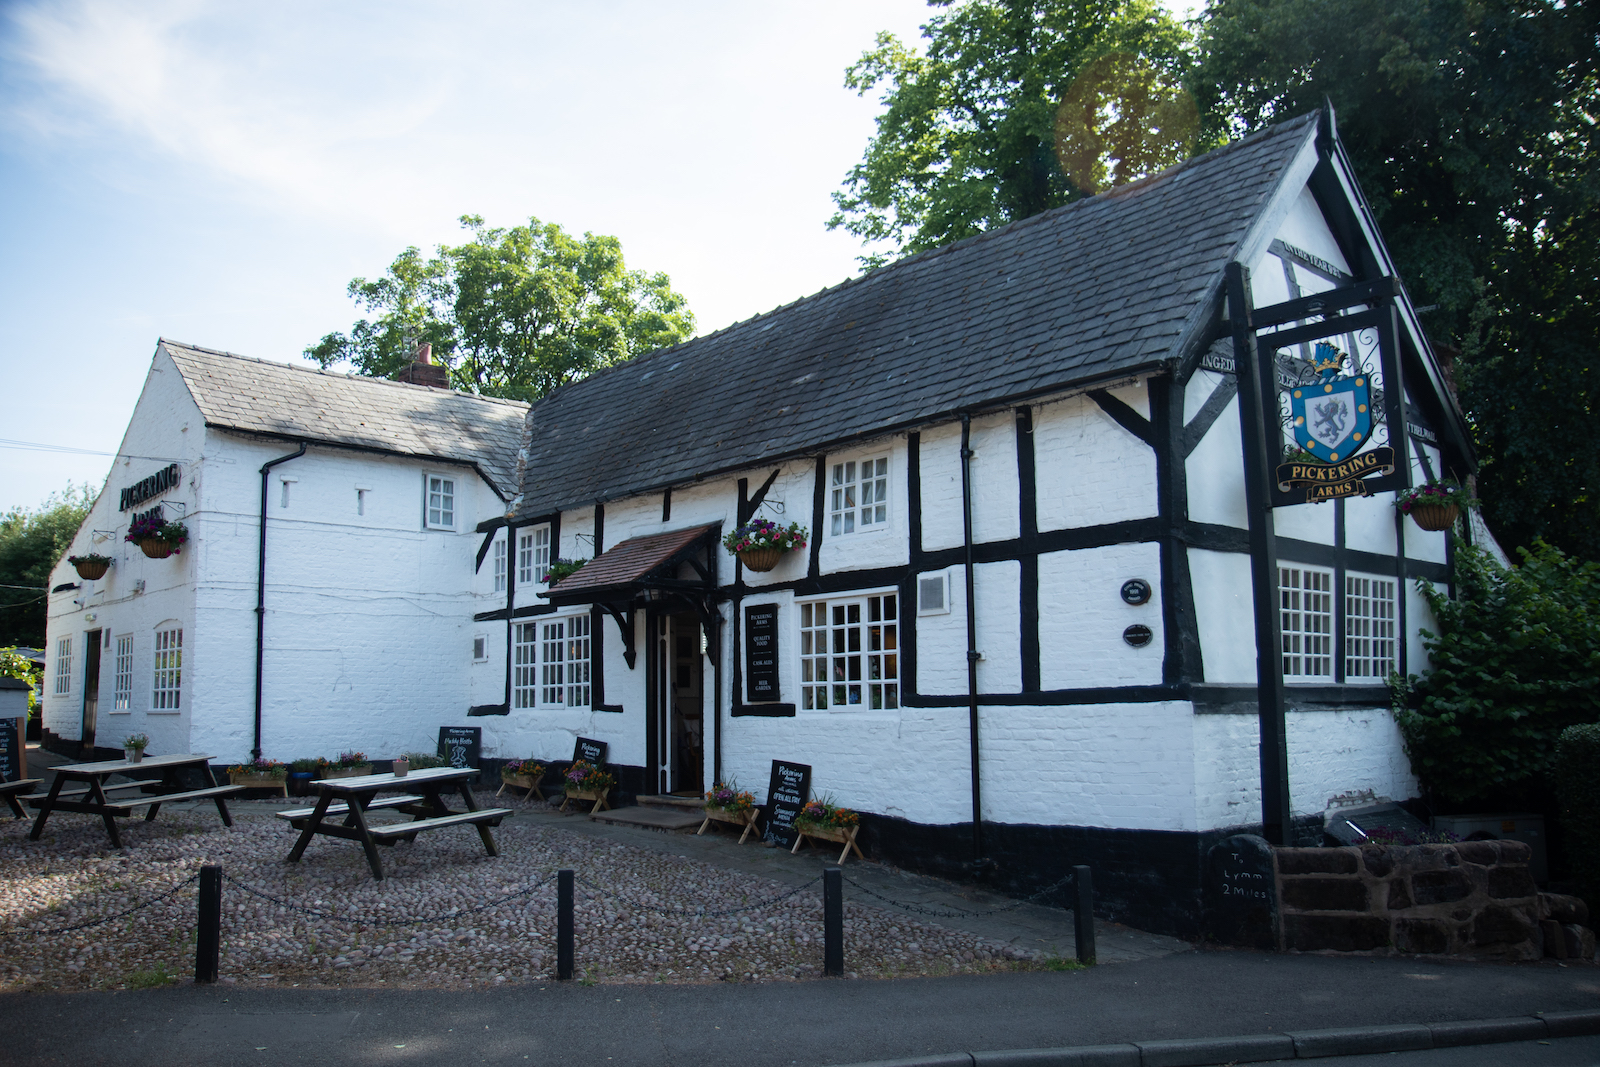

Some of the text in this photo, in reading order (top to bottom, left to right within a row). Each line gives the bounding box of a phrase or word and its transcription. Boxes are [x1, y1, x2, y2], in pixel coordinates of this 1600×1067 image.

[1294, 247, 1309, 261] THE
[1309, 254, 1328, 272] YEAR
[1292, 452, 1377, 480] PICKERING
[119, 463, 180, 511] PICKERING
[1316, 482, 1352, 496] ARMS
[778, 765, 803, 782] Pickering
[773, 792, 785, 801] OPEN
[792, 796, 801, 805] DAY
[1232, 853, 1243, 863] To
[1224, 870, 1262, 880] Lymm
[1222, 883, 1266, 898] 2 Miles
